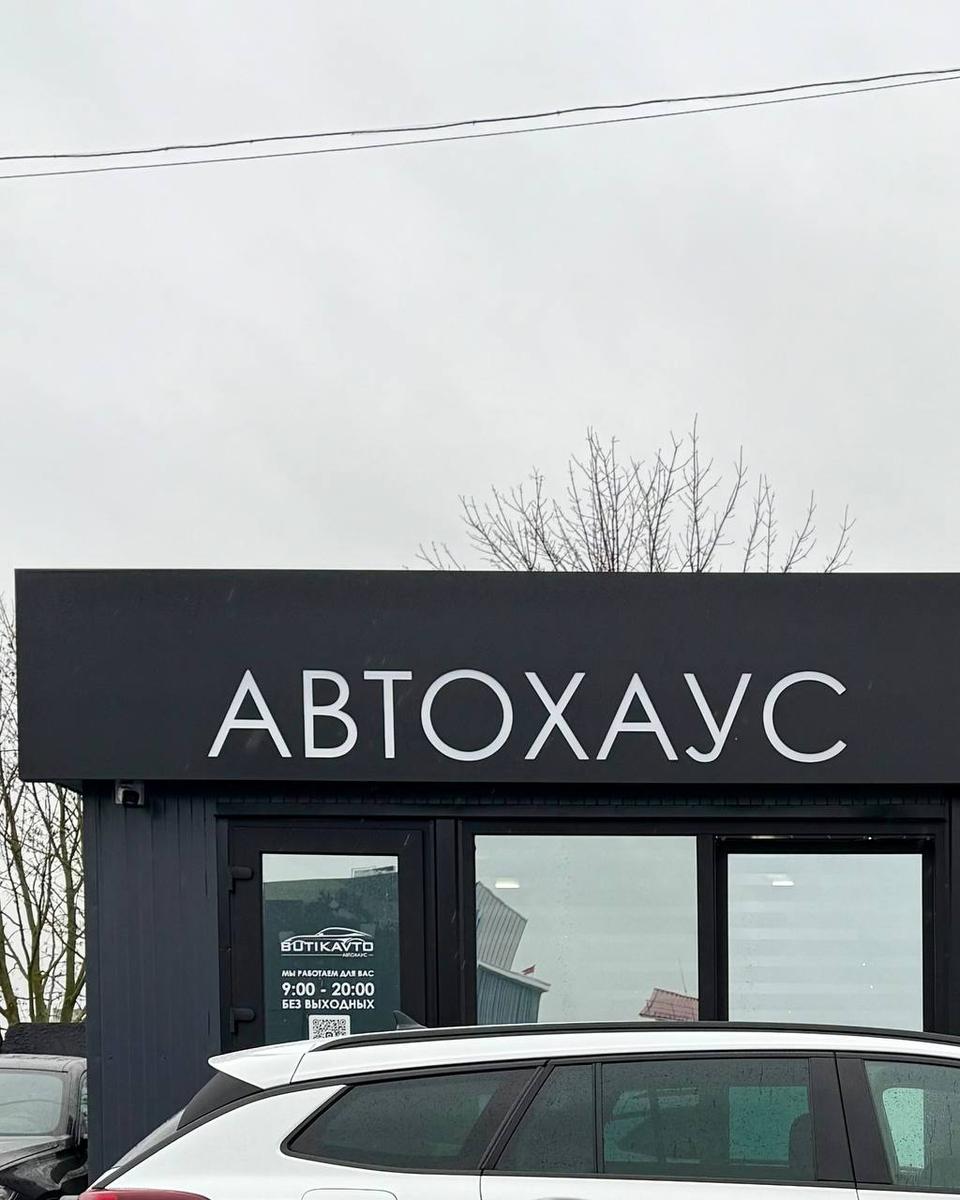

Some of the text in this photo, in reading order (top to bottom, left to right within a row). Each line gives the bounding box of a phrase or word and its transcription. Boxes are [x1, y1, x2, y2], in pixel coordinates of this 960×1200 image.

[207, 669, 847, 763] АВТОХАУС
[281, 941, 374, 952] BUTIKAVTO
[340, 970, 356, 978] ДЛЯ
[281, 982, 315, 996] 9:00
[331, 982, 375, 996] 20:00
[282, 999, 375, 1010] БЕЗ ВЫХОДНЫХ
